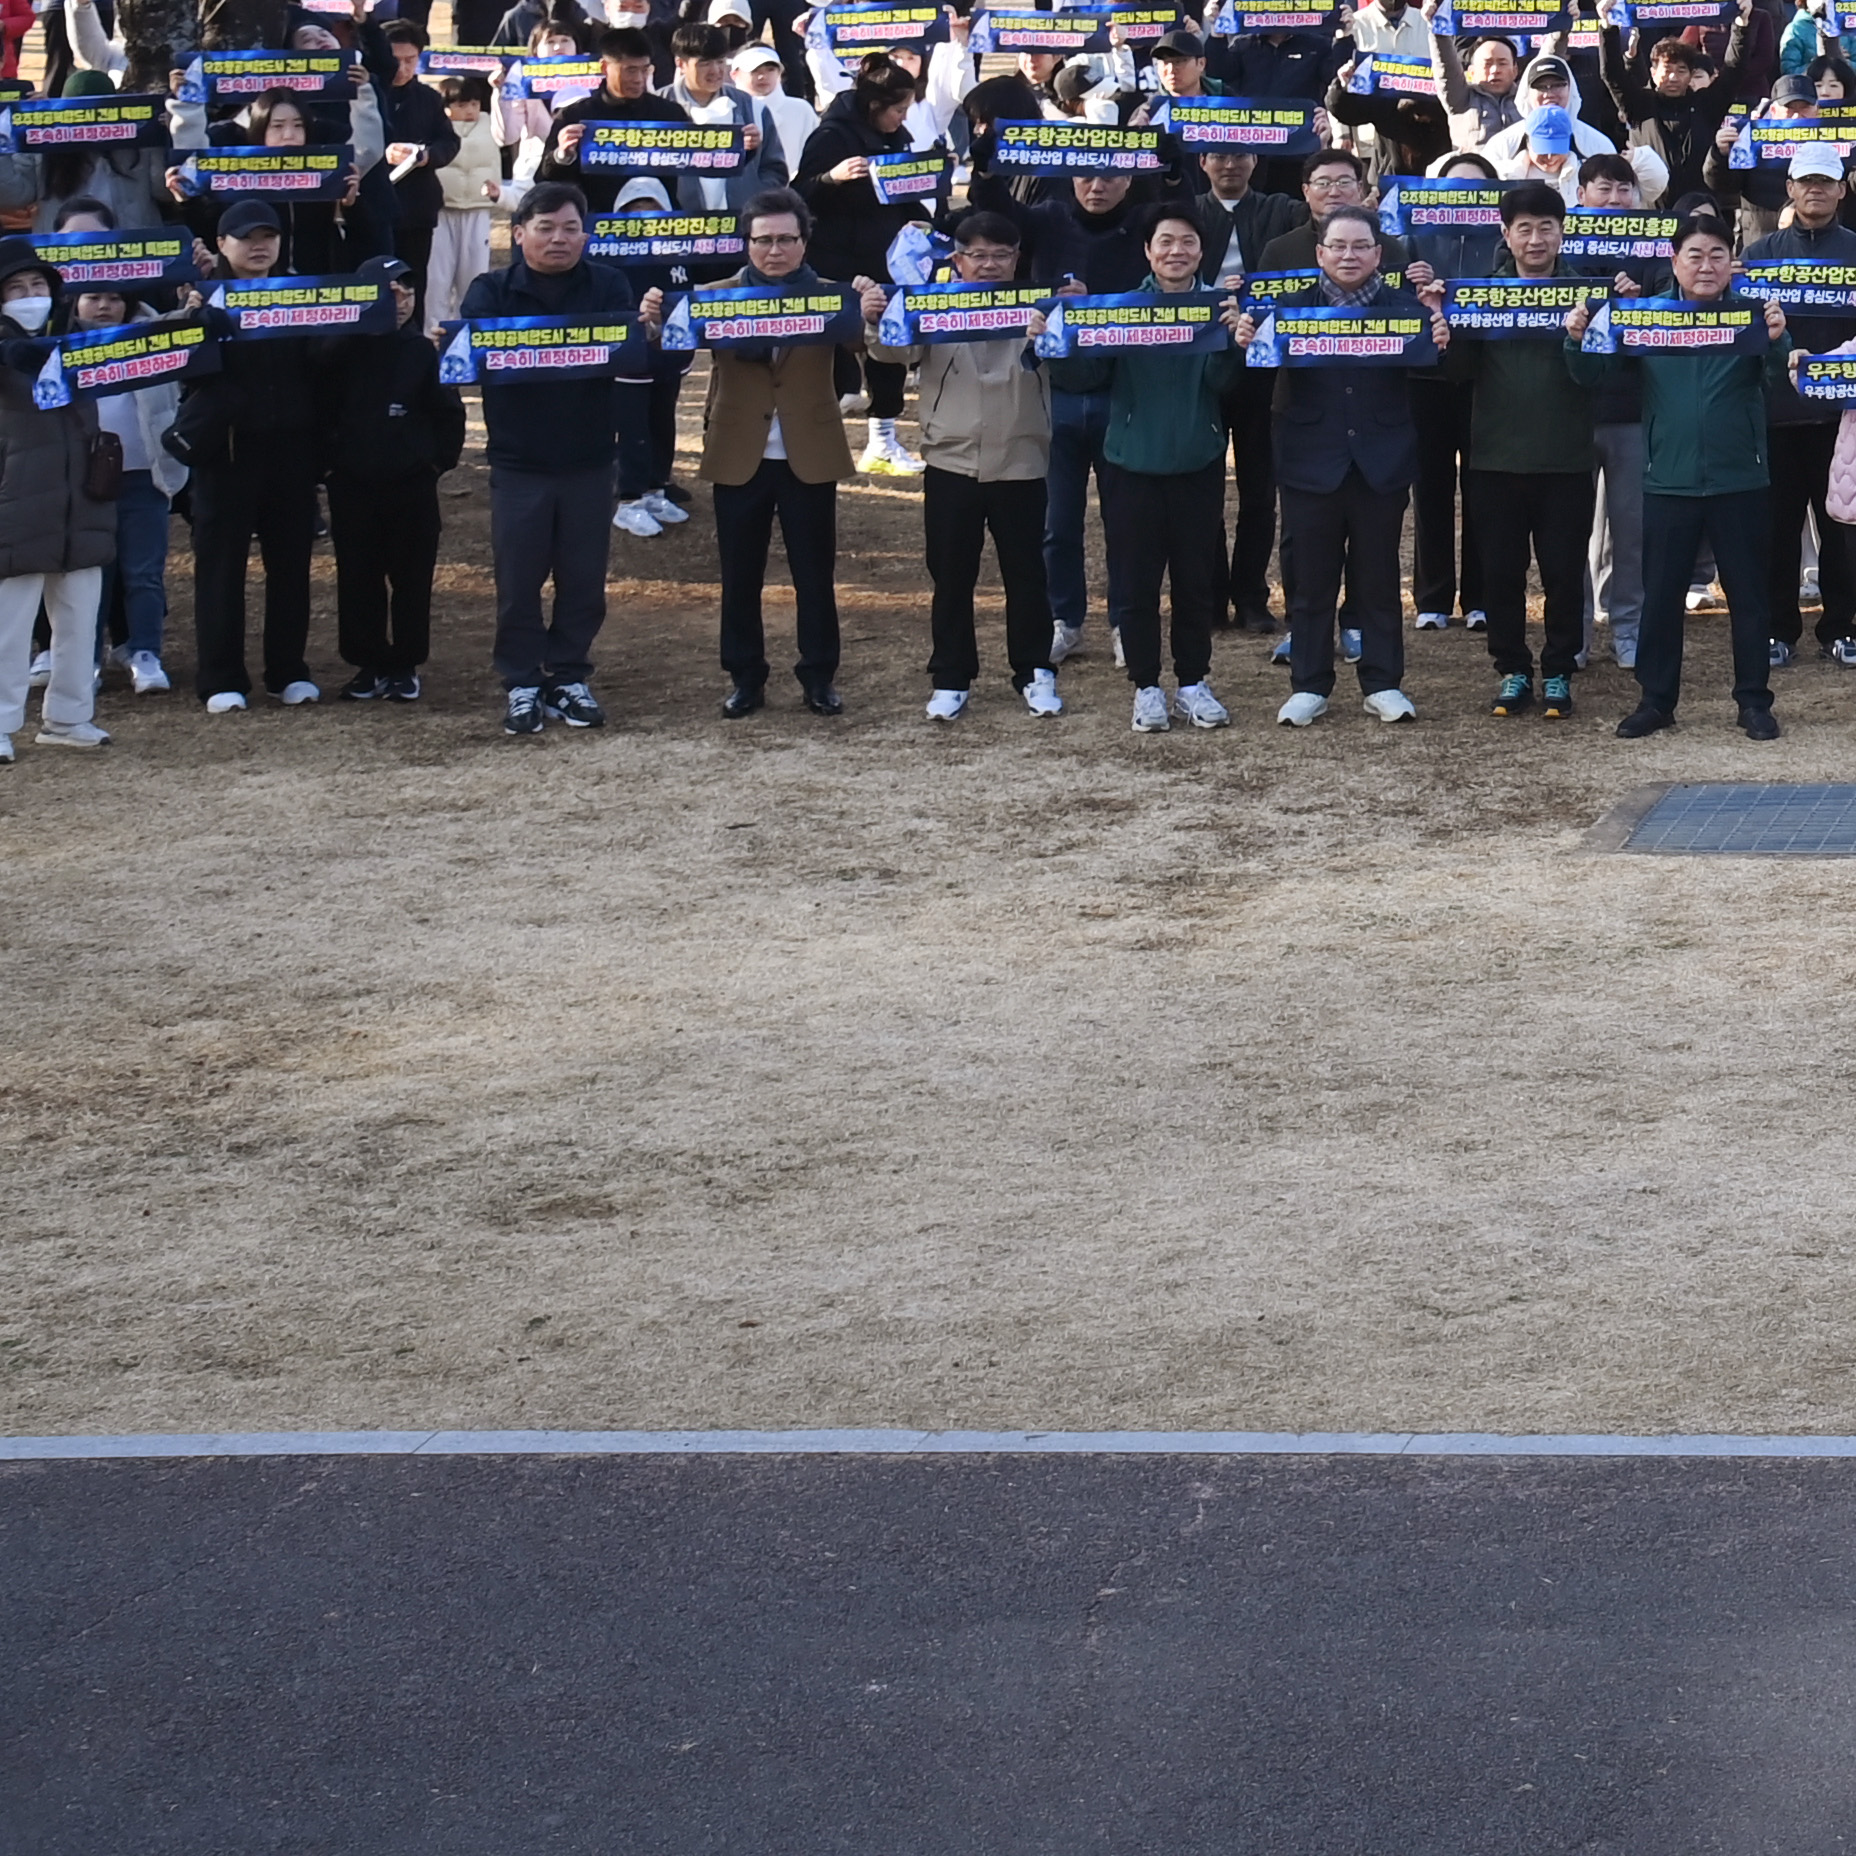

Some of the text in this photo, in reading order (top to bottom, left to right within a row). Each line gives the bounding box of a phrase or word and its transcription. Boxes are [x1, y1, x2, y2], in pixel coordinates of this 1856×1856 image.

[11, 105, 153, 126] 우주항공복합도시 건설 특별법
[1170, 107, 1304, 125] 우주항공복합도시 건설 특별법
[26, 122, 137, 144] 조속히 제정하라!!
[1183, 125, 1288, 143] 조속히 제정하라!!
[197, 155, 338, 171] 우주항공복합도시 건설 특별법
[211, 172, 321, 190] 조속히 제정하라!!
[670, 265, 688, 284] NY
[225, 285, 378, 308] 우주항공복합도시 건설 특별법
[689, 295, 842, 318] 우주항공복합도시 건설 특별법
[241, 304, 360, 329] 조속히 제정하라!!
[1063, 306, 1211, 325] 우주항공복합도시 건설 특별법
[1610, 311, 1751, 325] 우주항공복합도시 건설 특별법
[470, 325, 628, 348] 우주항공복합도시 건설 특별법
[705, 315, 825, 339] 조속히 제정하라!!
[1078, 325, 1194, 346] 조속히 제정하라!!
[1275, 319, 1422, 334] 우주항공복합도시 건설 특별법
[1624, 328, 1734, 346] 조속히 제정하라!!
[60, 326, 204, 369] 우주항공복합도시 건설 특별법
[1289, 337, 1404, 355] 조속히 제정하라!!
[487, 345, 609, 370] 조속히 제정하라!!
[77, 348, 190, 389] 조속히 제정하라!!
